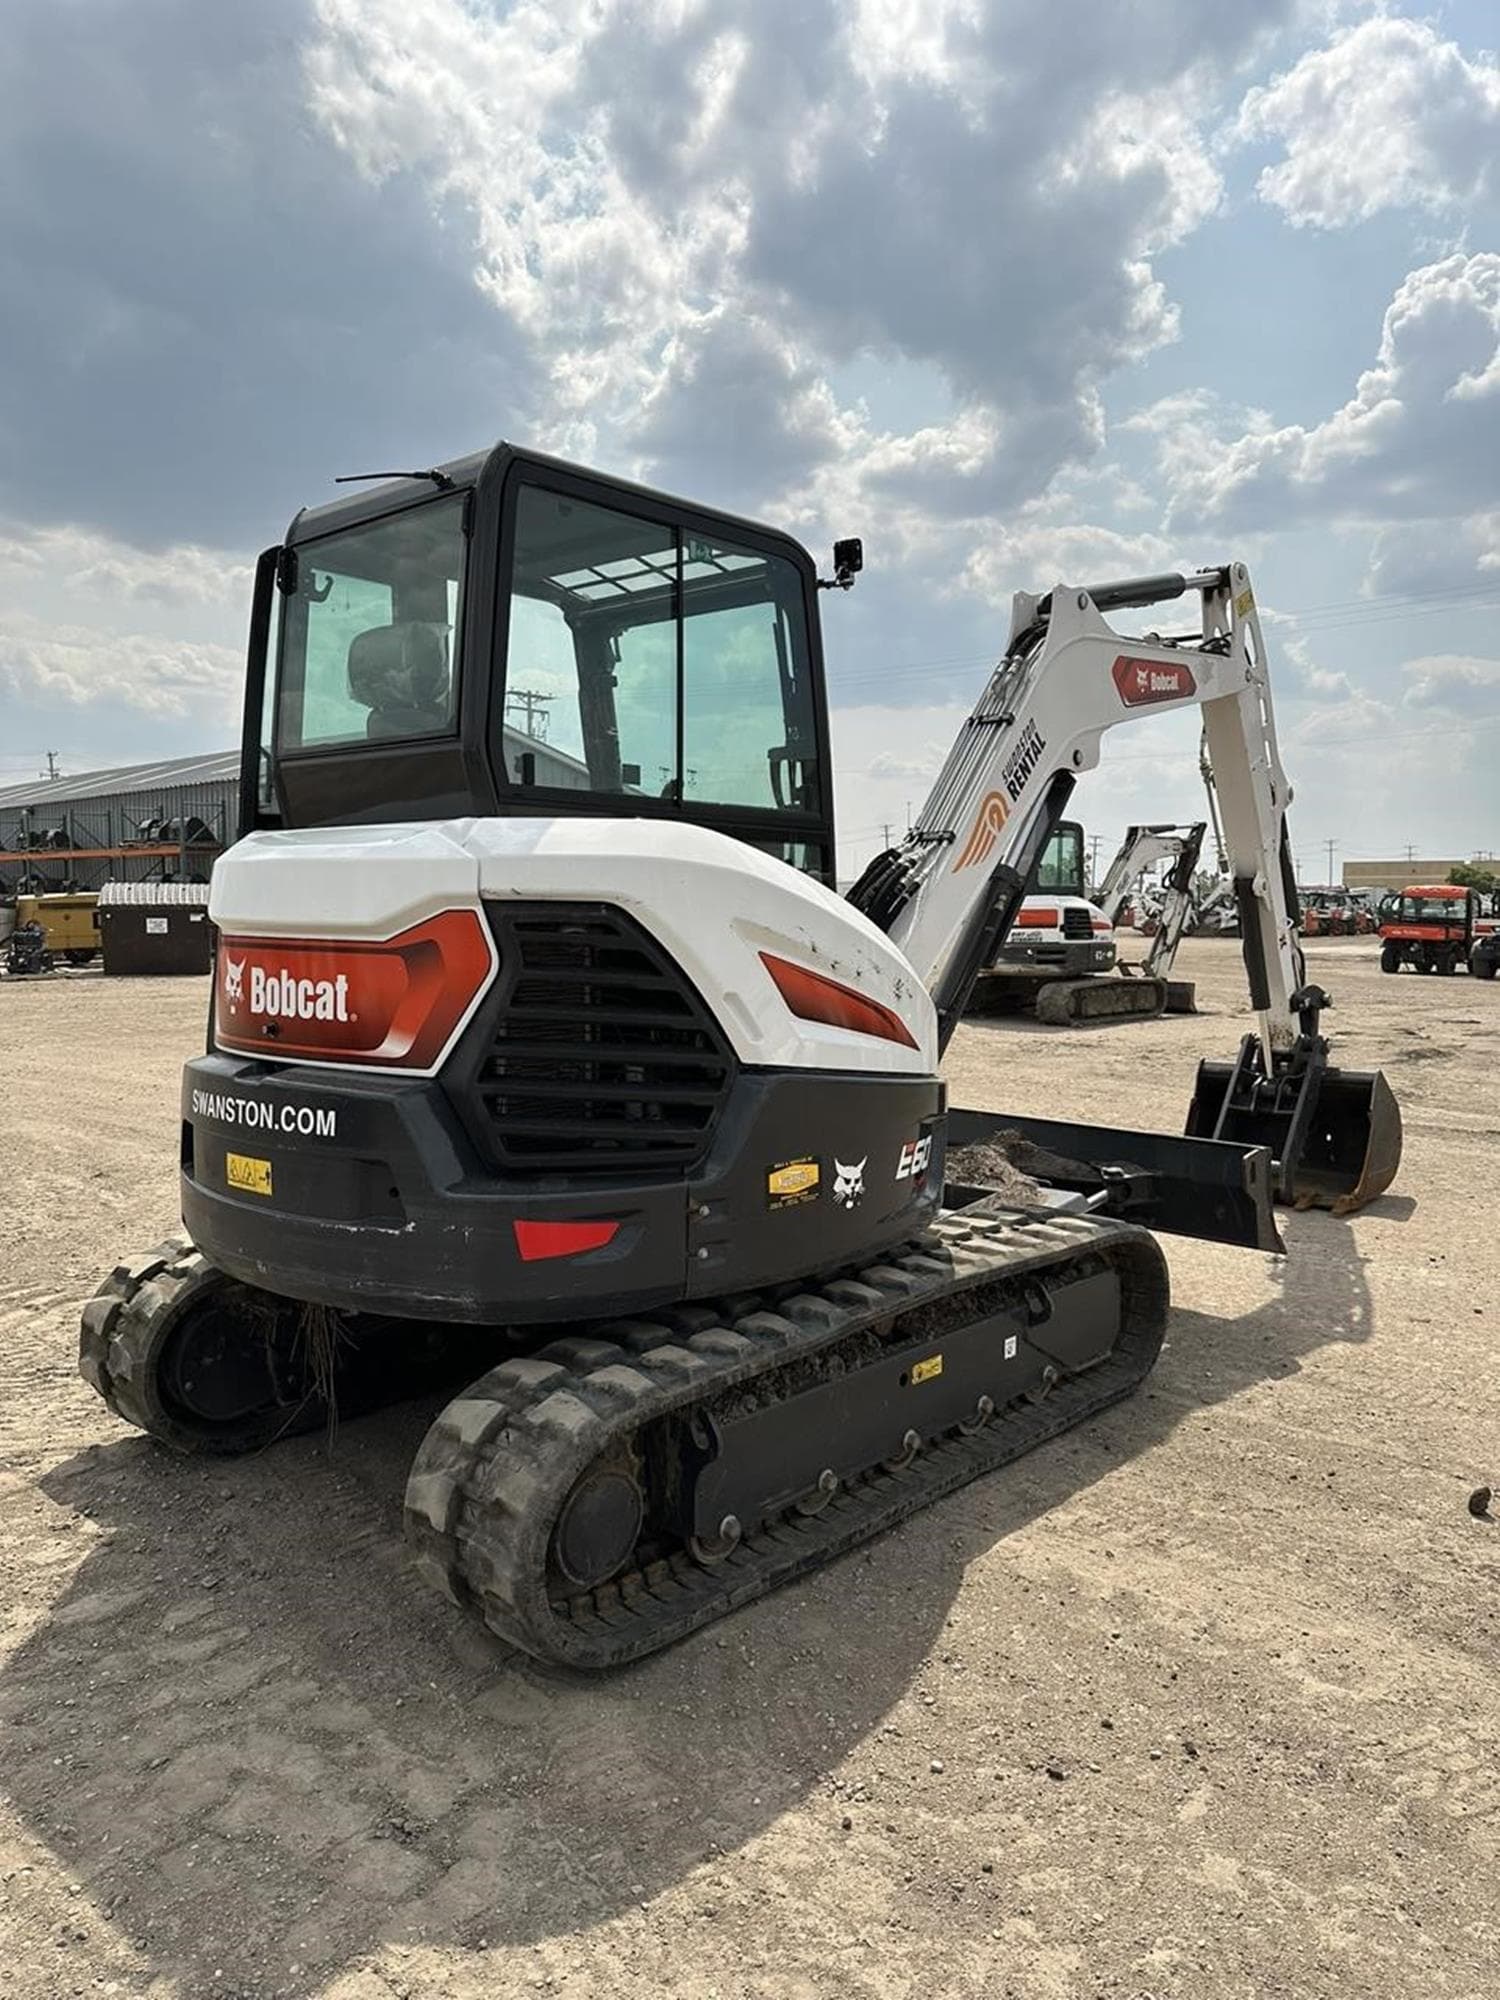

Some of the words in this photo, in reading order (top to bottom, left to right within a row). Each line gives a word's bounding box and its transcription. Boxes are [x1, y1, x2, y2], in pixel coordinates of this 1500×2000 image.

[1150, 672, 1179, 691] Bobcat
[1006, 731, 1047, 803] RENTAL
[250, 965, 350, 1022] Bobcat
[191, 1088, 337, 1138] SWANSTON.COM
[895, 1135, 932, 1180] E60
